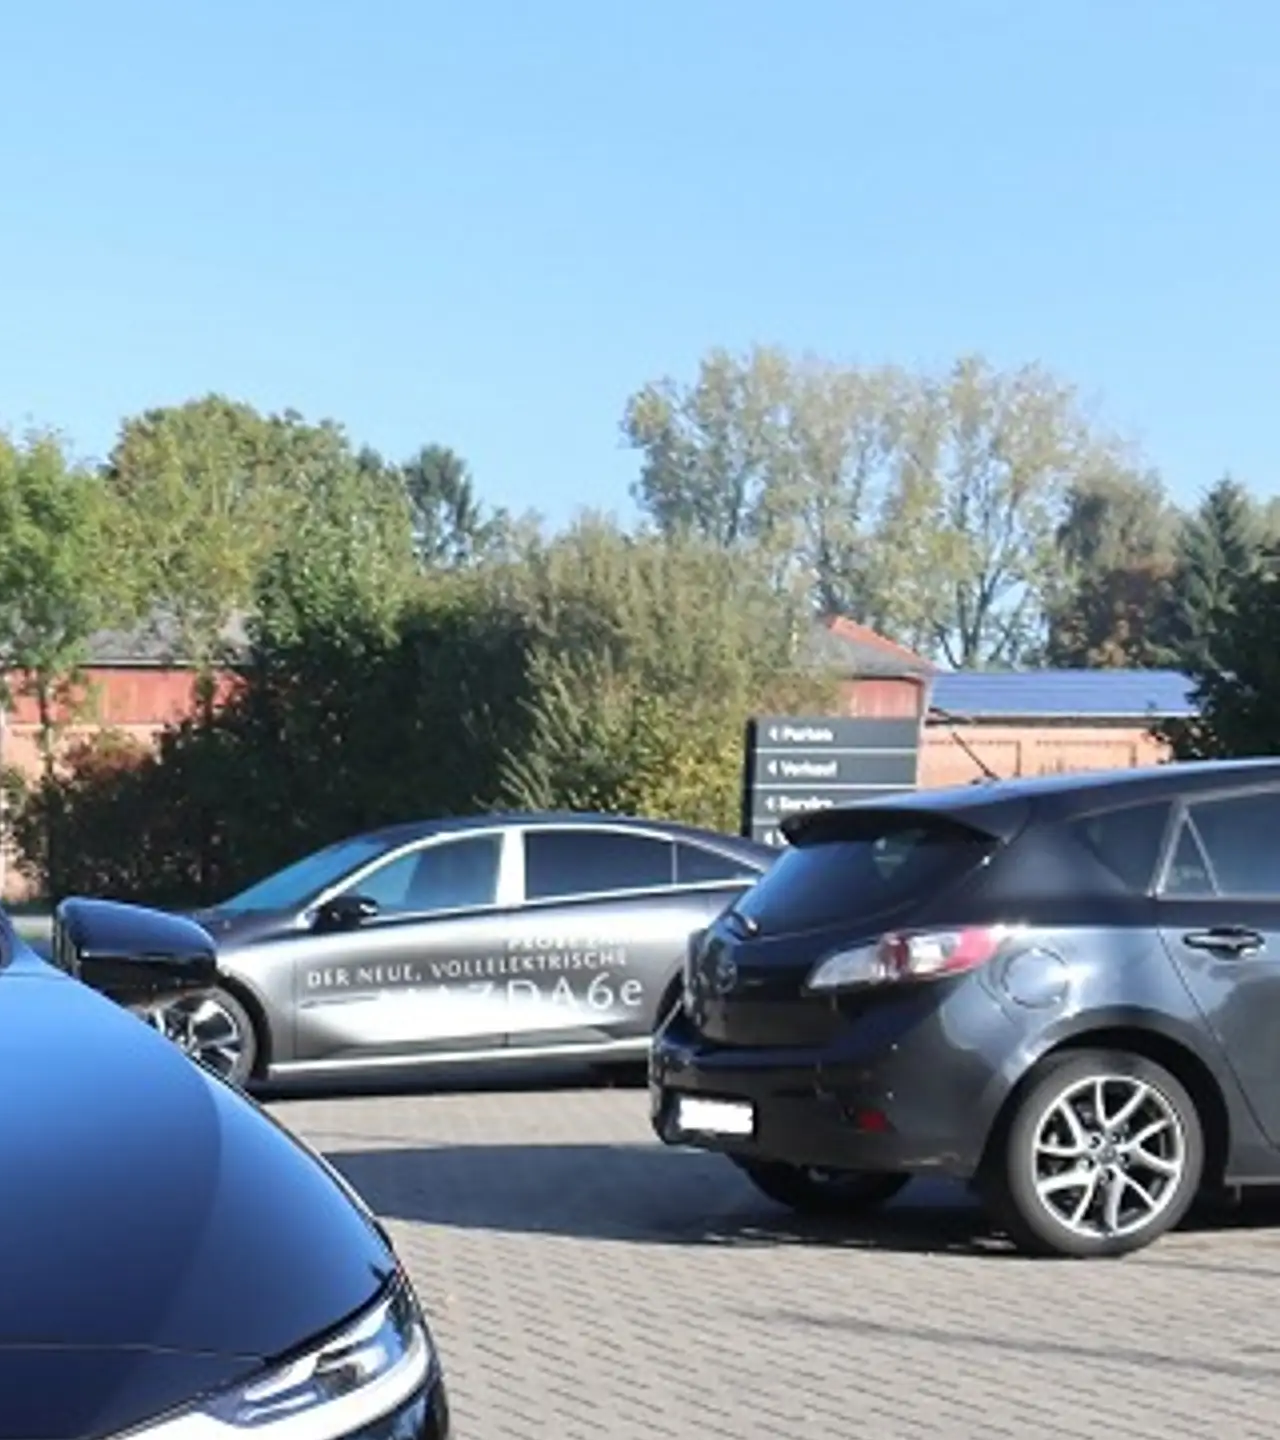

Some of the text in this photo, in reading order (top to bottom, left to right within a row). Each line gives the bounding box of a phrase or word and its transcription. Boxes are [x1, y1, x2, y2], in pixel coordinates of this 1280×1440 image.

[779, 759, 838, 777] Verkauf
[307, 968, 350, 989] DER
[430, 949, 627, 979] VOLLELEKTRISCHE
